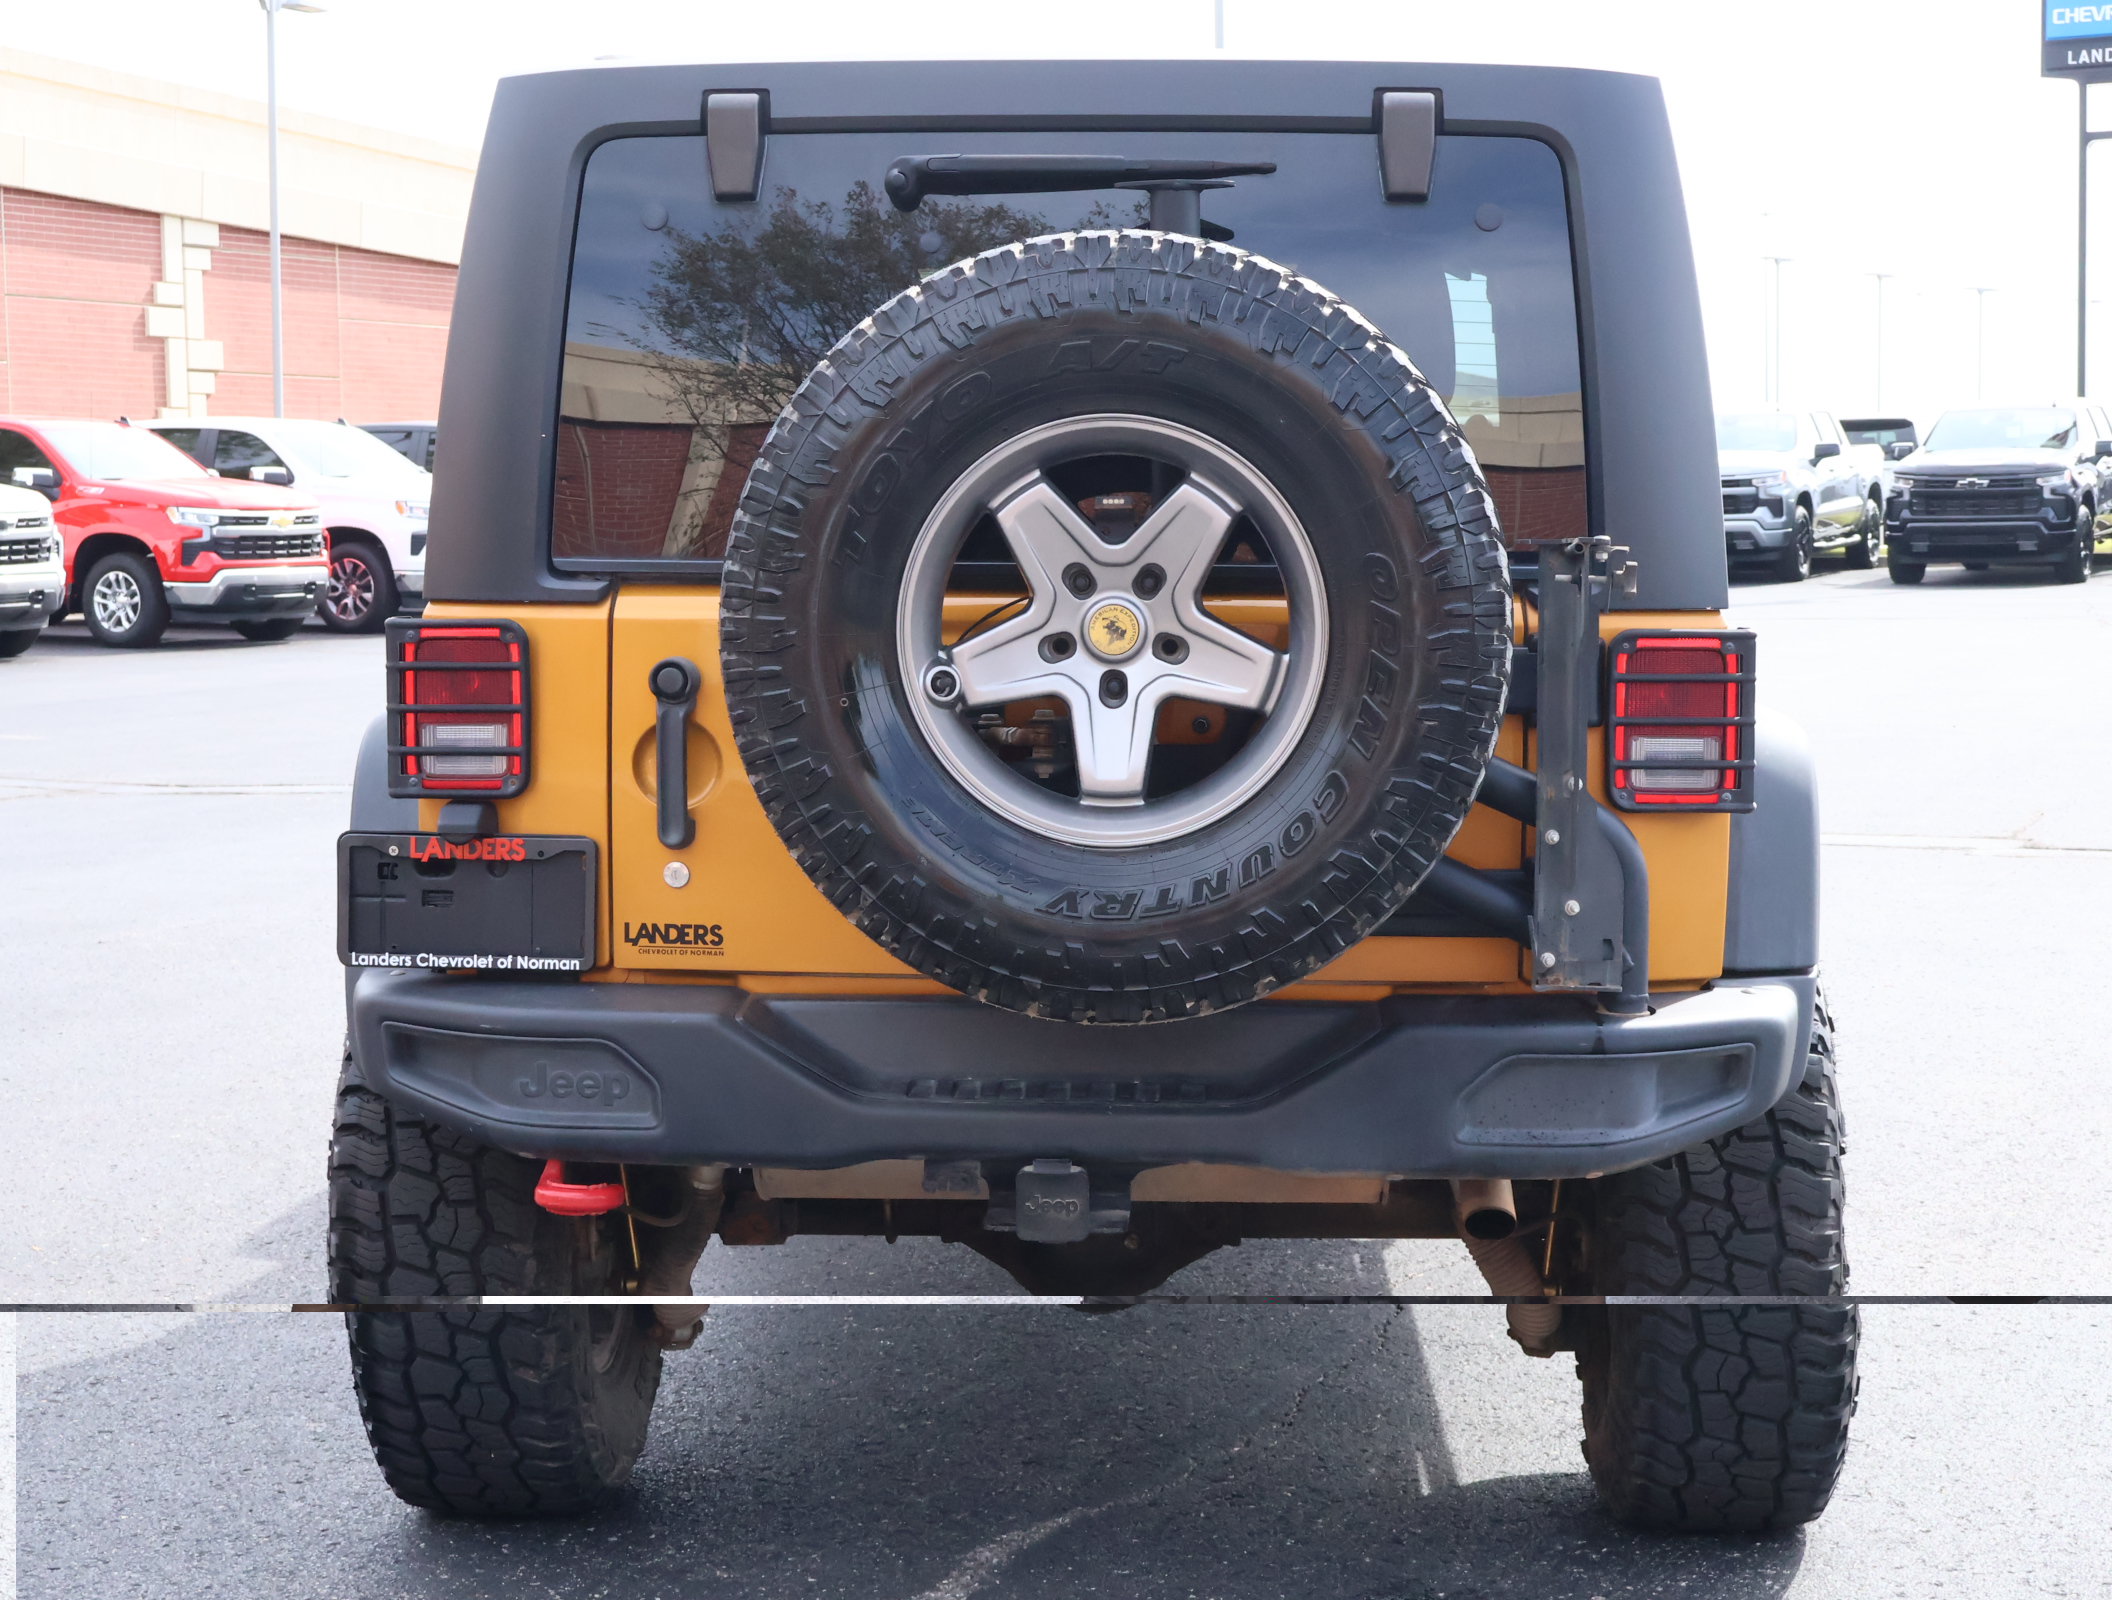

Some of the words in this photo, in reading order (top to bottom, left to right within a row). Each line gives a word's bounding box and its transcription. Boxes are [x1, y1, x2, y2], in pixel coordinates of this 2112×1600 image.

[830, 370, 992, 567] TOYO
[1347, 553, 1401, 760] OPEN
[410, 837, 526, 862] LANDERS
[1034, 770, 1349, 920] COUNTRY
[624, 922, 723, 946] LANDERS
[351, 952, 412, 967] Landers
[416, 953, 493, 969] Chevrolet
[497, 955, 513, 969] of
[517, 955, 580, 971] Norman
[690, 949, 724, 957] NORMAN
[518, 1060, 631, 1107] Jeep
[1024, 1194, 1080, 1217] Jeep
